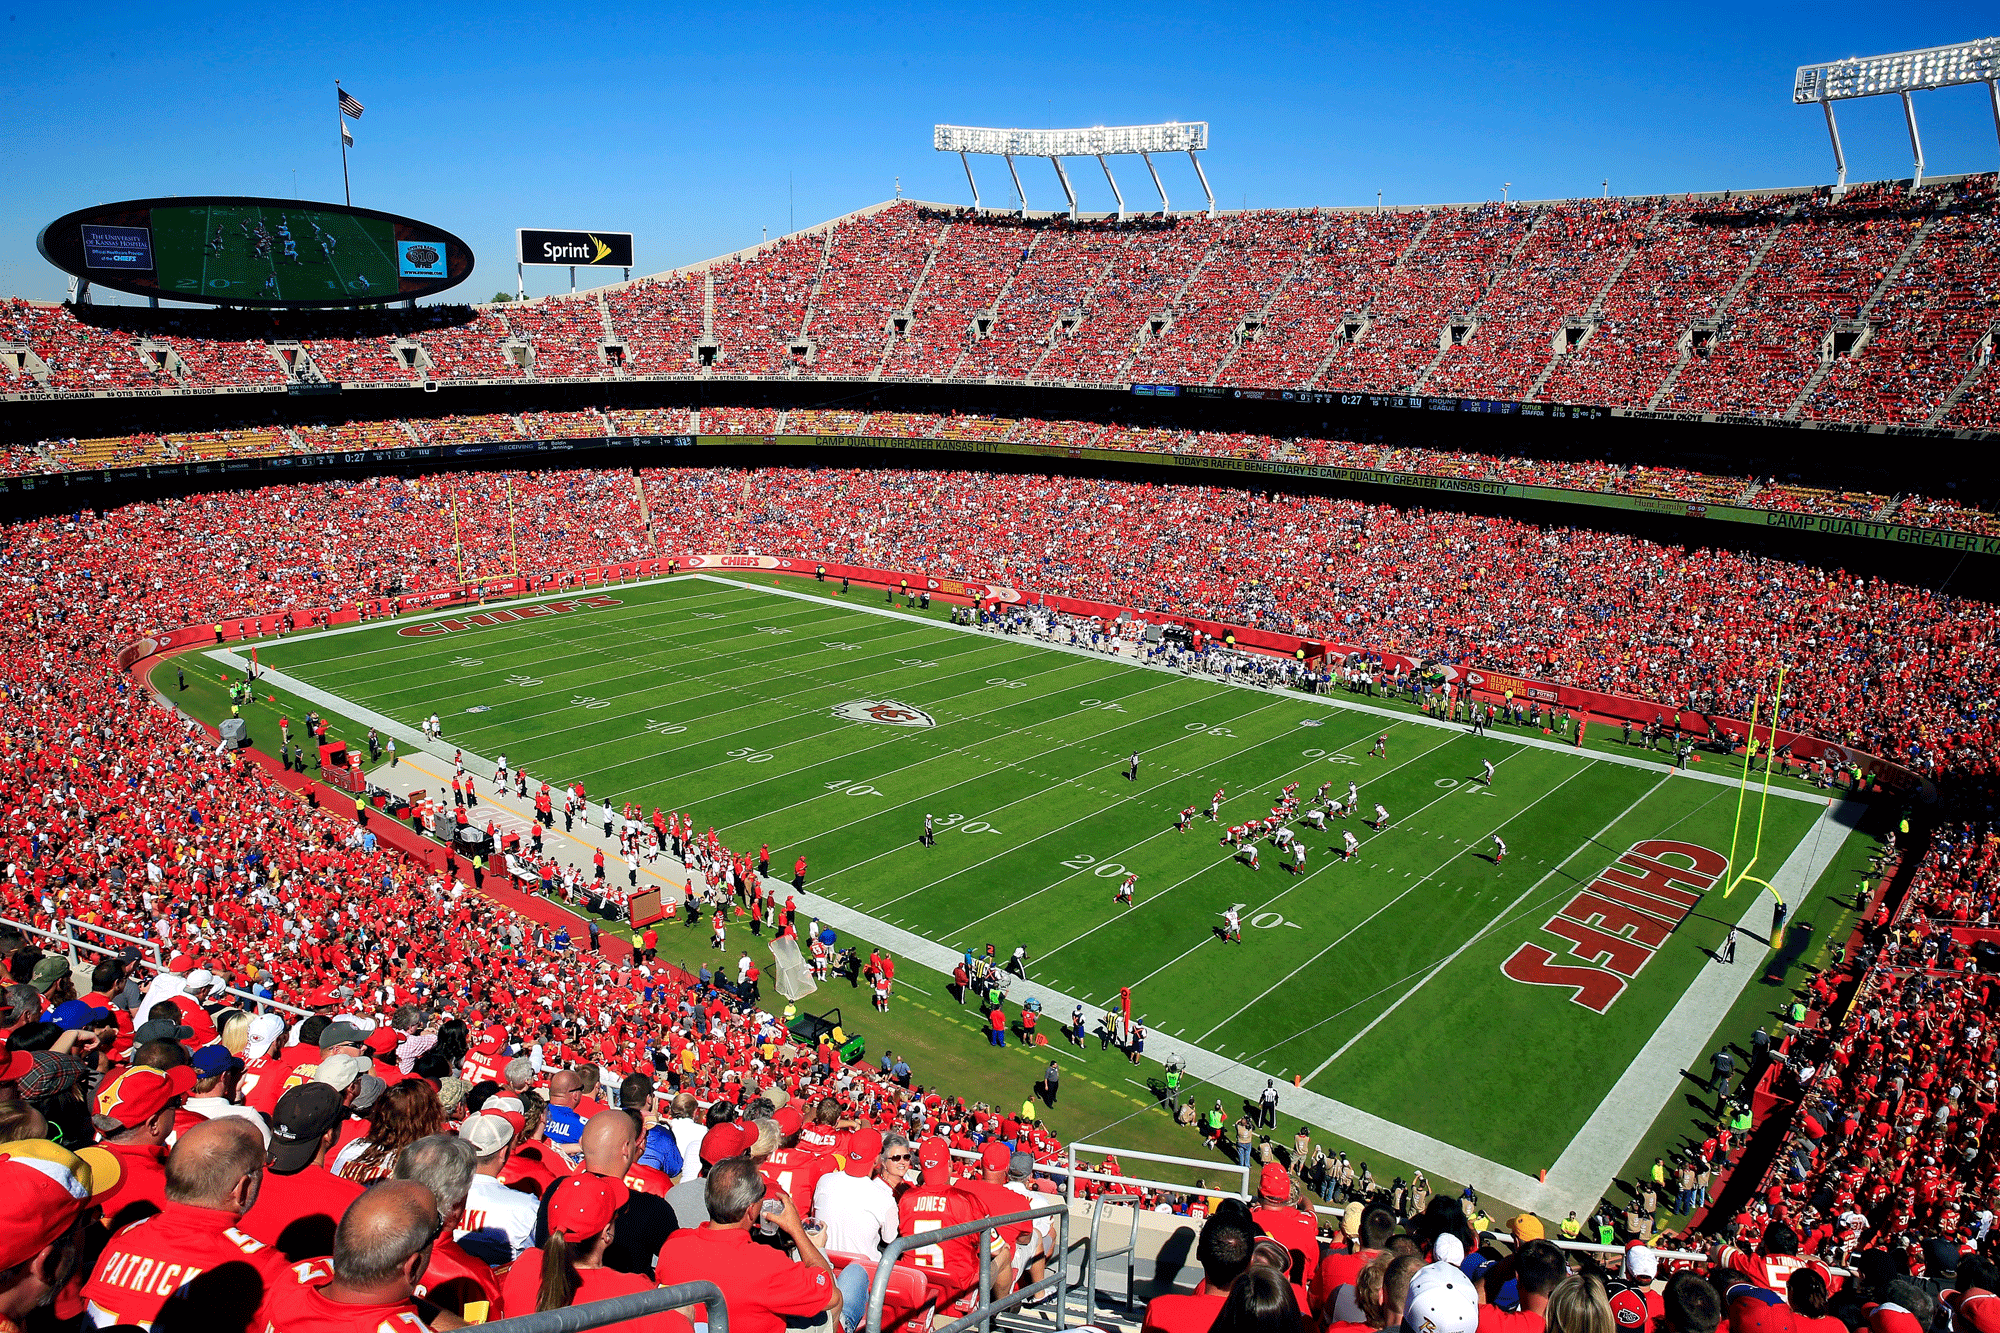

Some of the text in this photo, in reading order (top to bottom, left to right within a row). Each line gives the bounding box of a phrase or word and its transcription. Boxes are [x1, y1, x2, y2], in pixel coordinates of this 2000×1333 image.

[410, 250, 435, 263] 810
[543, 242, 590, 262] Sprint
[54, 392, 95, 400] BUCHANAN
[1341, 395, 1362, 405] 0:27
[1633, 410, 1674, 420] CHRISTIAN
[815, 437, 999, 453] CAMP QUALITY GREATER KANSAS CITY
[345, 453, 365, 463] 0:27
[1174, 457, 1509, 495] TODAY'S RAFFLE BENEFICIARY IS CAMP QUALITY GREATER KANSAS CITY
[1634, 498, 1655, 508] Hunt
[1657, 501, 1684, 513] Family
[1766, 512, 1978, 551] CAMP QUALITY GREATER
[721, 556, 760, 566] CHIEFS
[397, 594, 624, 638] CHIEFS
[1490, 675, 1525, 688] HISPANIC
[570, 694, 611, 709] 30
[726, 746, 774, 764] 50
[823, 779, 875, 797] 40
[934, 813, 991, 835] 30
[1060, 853, 1126, 878] 20
[1500, 839, 1730, 1015] CHIEFS
[462, 1060, 498, 1084] 35
[800, 1128, 837, 1147] CHARLES
[913, 1195, 947, 1213] JONES
[913, 1219, 945, 1269] 5
[99, 1250, 203, 1298] PATRICK
